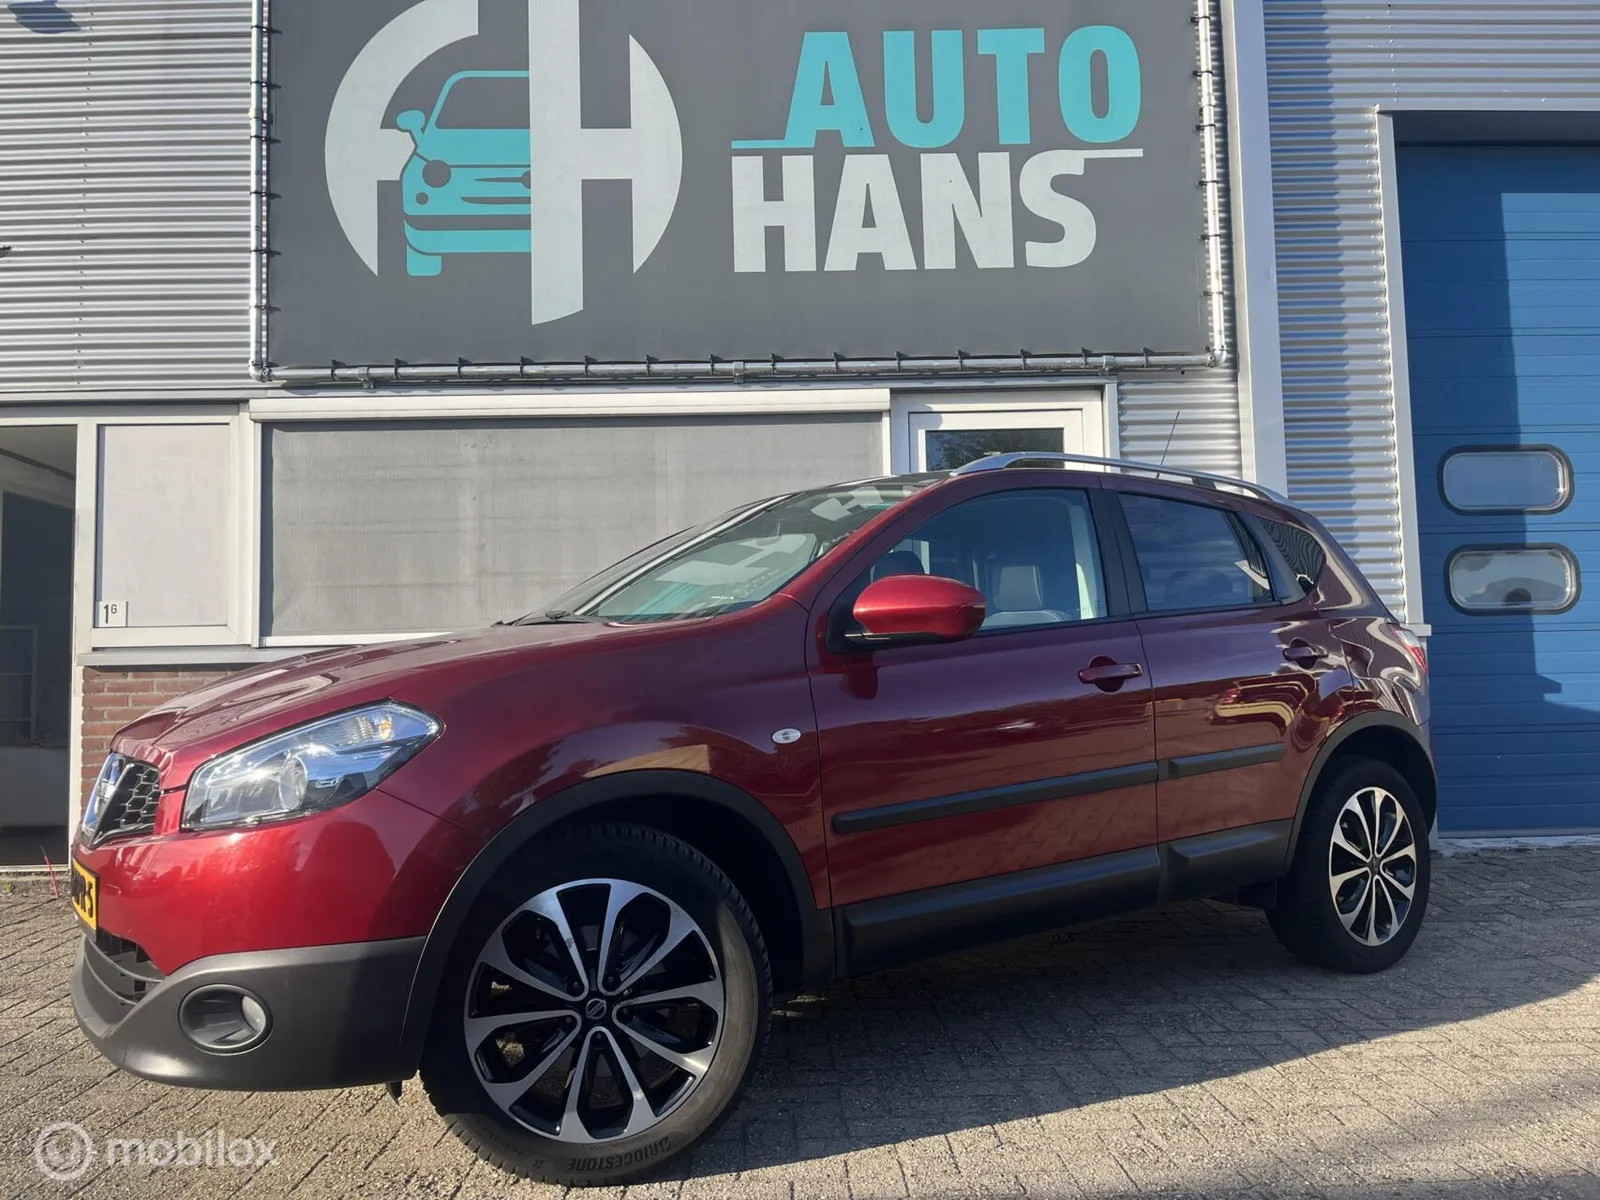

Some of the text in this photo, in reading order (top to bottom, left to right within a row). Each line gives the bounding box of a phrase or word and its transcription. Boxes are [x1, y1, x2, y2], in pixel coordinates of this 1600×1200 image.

[732, 25, 1141, 148] AUTO
[732, 148, 1144, 273] HANS
[567, 1136, 673, 1172] BRIDGESTONE
